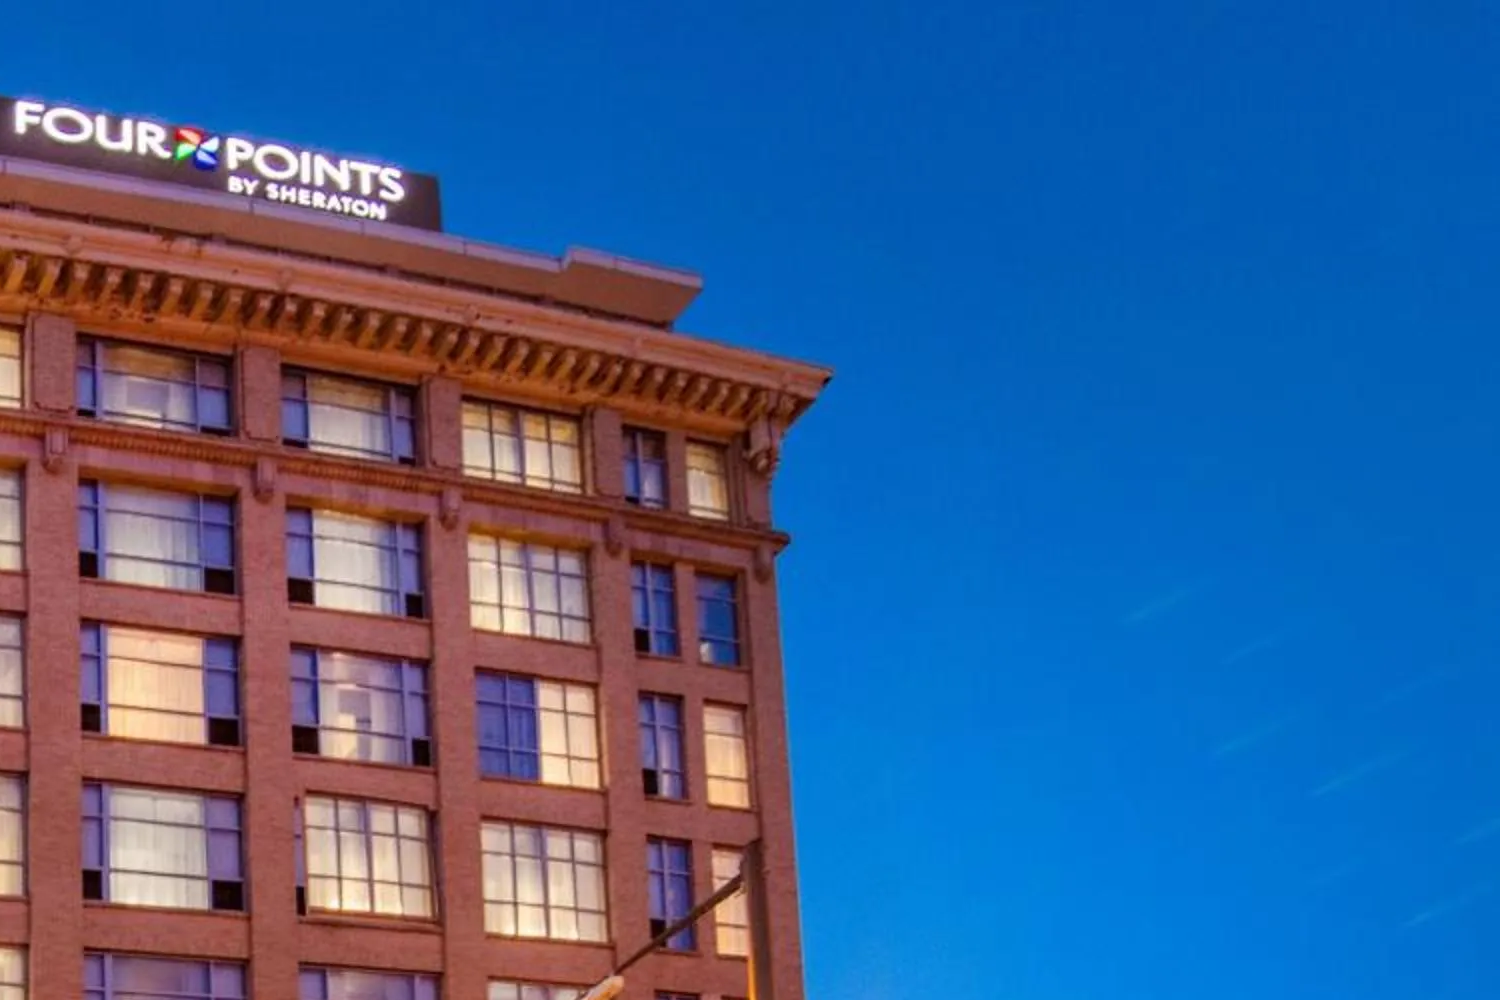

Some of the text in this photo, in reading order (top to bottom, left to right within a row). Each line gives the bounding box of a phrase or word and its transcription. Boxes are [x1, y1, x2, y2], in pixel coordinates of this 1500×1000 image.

[14, 99, 406, 203] FOUR POINTS
[227, 174, 388, 221] BY SHERATON
